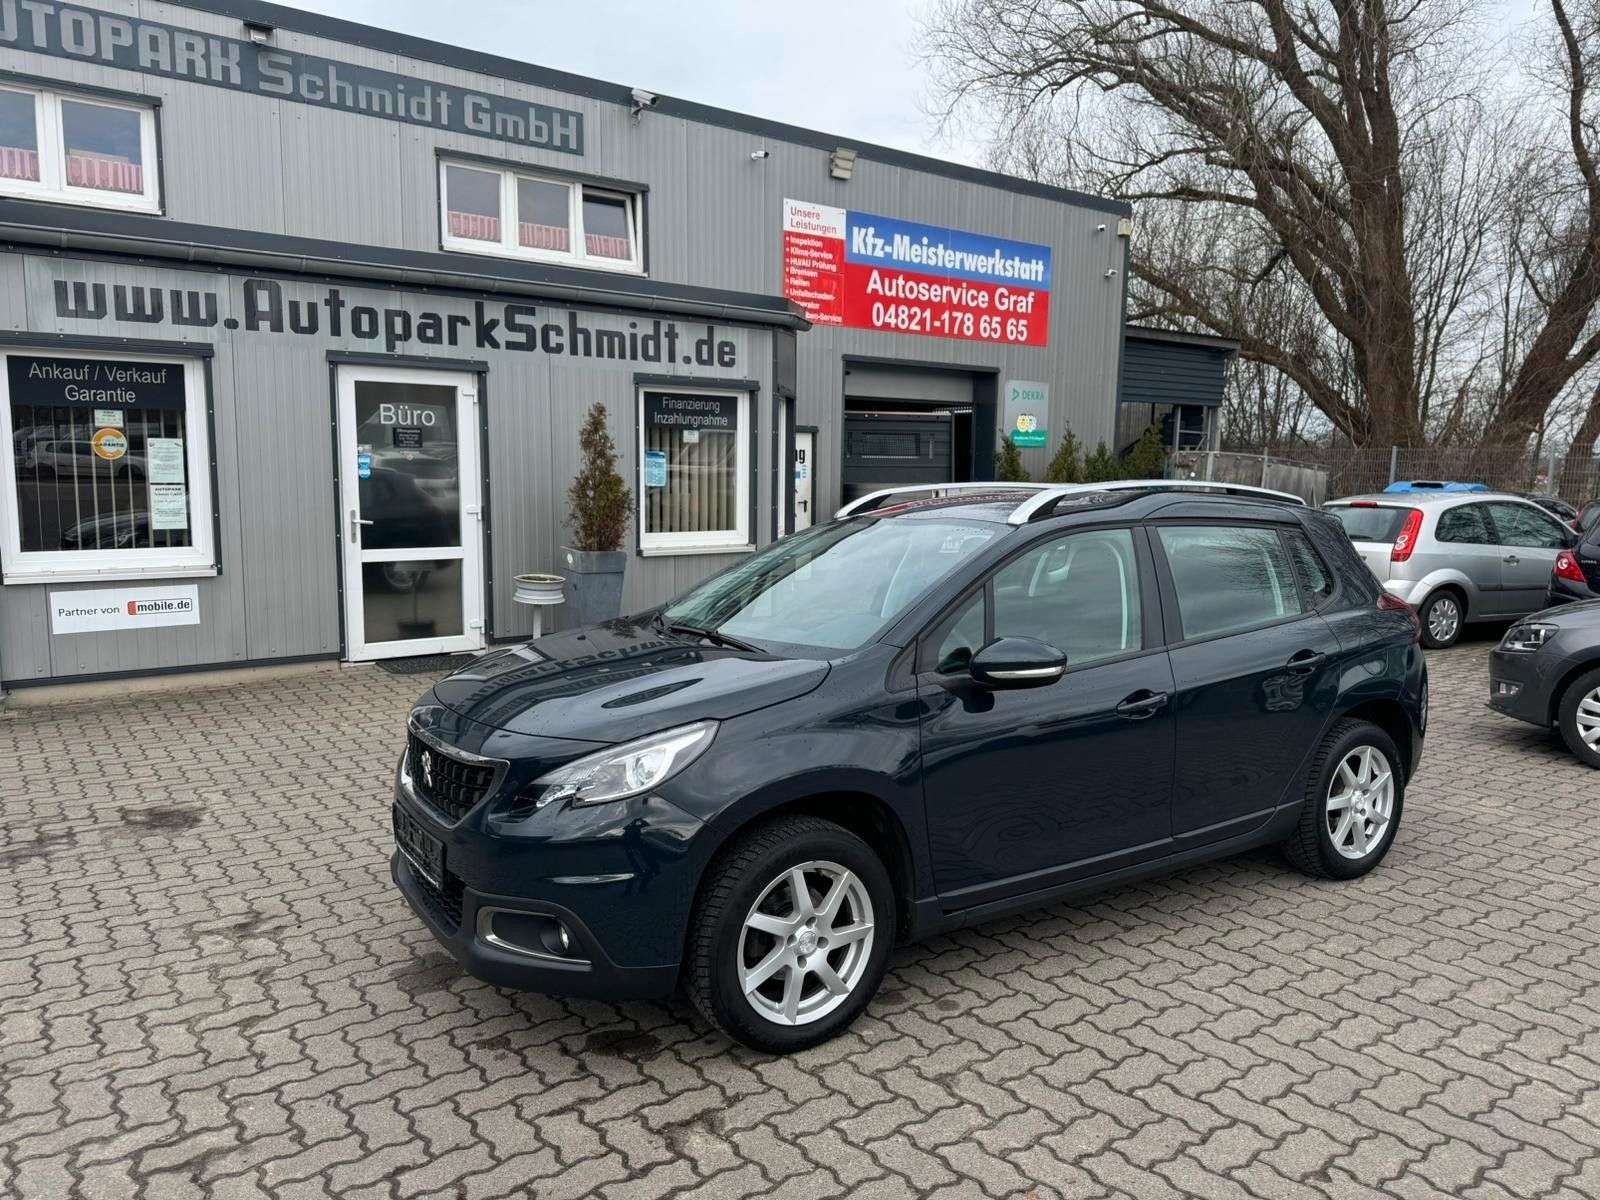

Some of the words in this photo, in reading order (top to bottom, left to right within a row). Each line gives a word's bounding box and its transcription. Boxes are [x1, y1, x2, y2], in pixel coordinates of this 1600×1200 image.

[258, 50, 452, 125] Schmidt
[464, 93, 578, 150] GmbH
[791, 206, 821, 220] Unsere
[791, 218, 837, 234] Leistungen
[790, 235, 823, 249] Inspektion
[790, 246, 833, 260] Klima-Service
[852, 226, 1044, 282] Kfz-Meisterwerkstatt
[866, 269, 989, 309] Autoservice
[994, 287, 1035, 314] Graf
[54, 278, 736, 368] www.AutoparkSchmidt.de
[872, 302, 974, 336] 04821-178
[979, 314, 1001, 339] 65
[1006, 317, 1028, 342] 65
[28, 362, 90, 381] Ankauf
[94, 367, 100, 381] /
[105, 366, 167, 384] Verkauf
[64, 384, 136, 403] Garantie
[1022, 390, 1045, 401] DEKRA
[380, 403, 435, 426] Büro
[662, 397, 720, 414] Finanzierung
[654, 412, 728, 427] Inzahlungnahme
[58, 607, 97, 617] Partner
[100, 606, 120, 615] von
[137, 600, 190, 612] mobile.de
